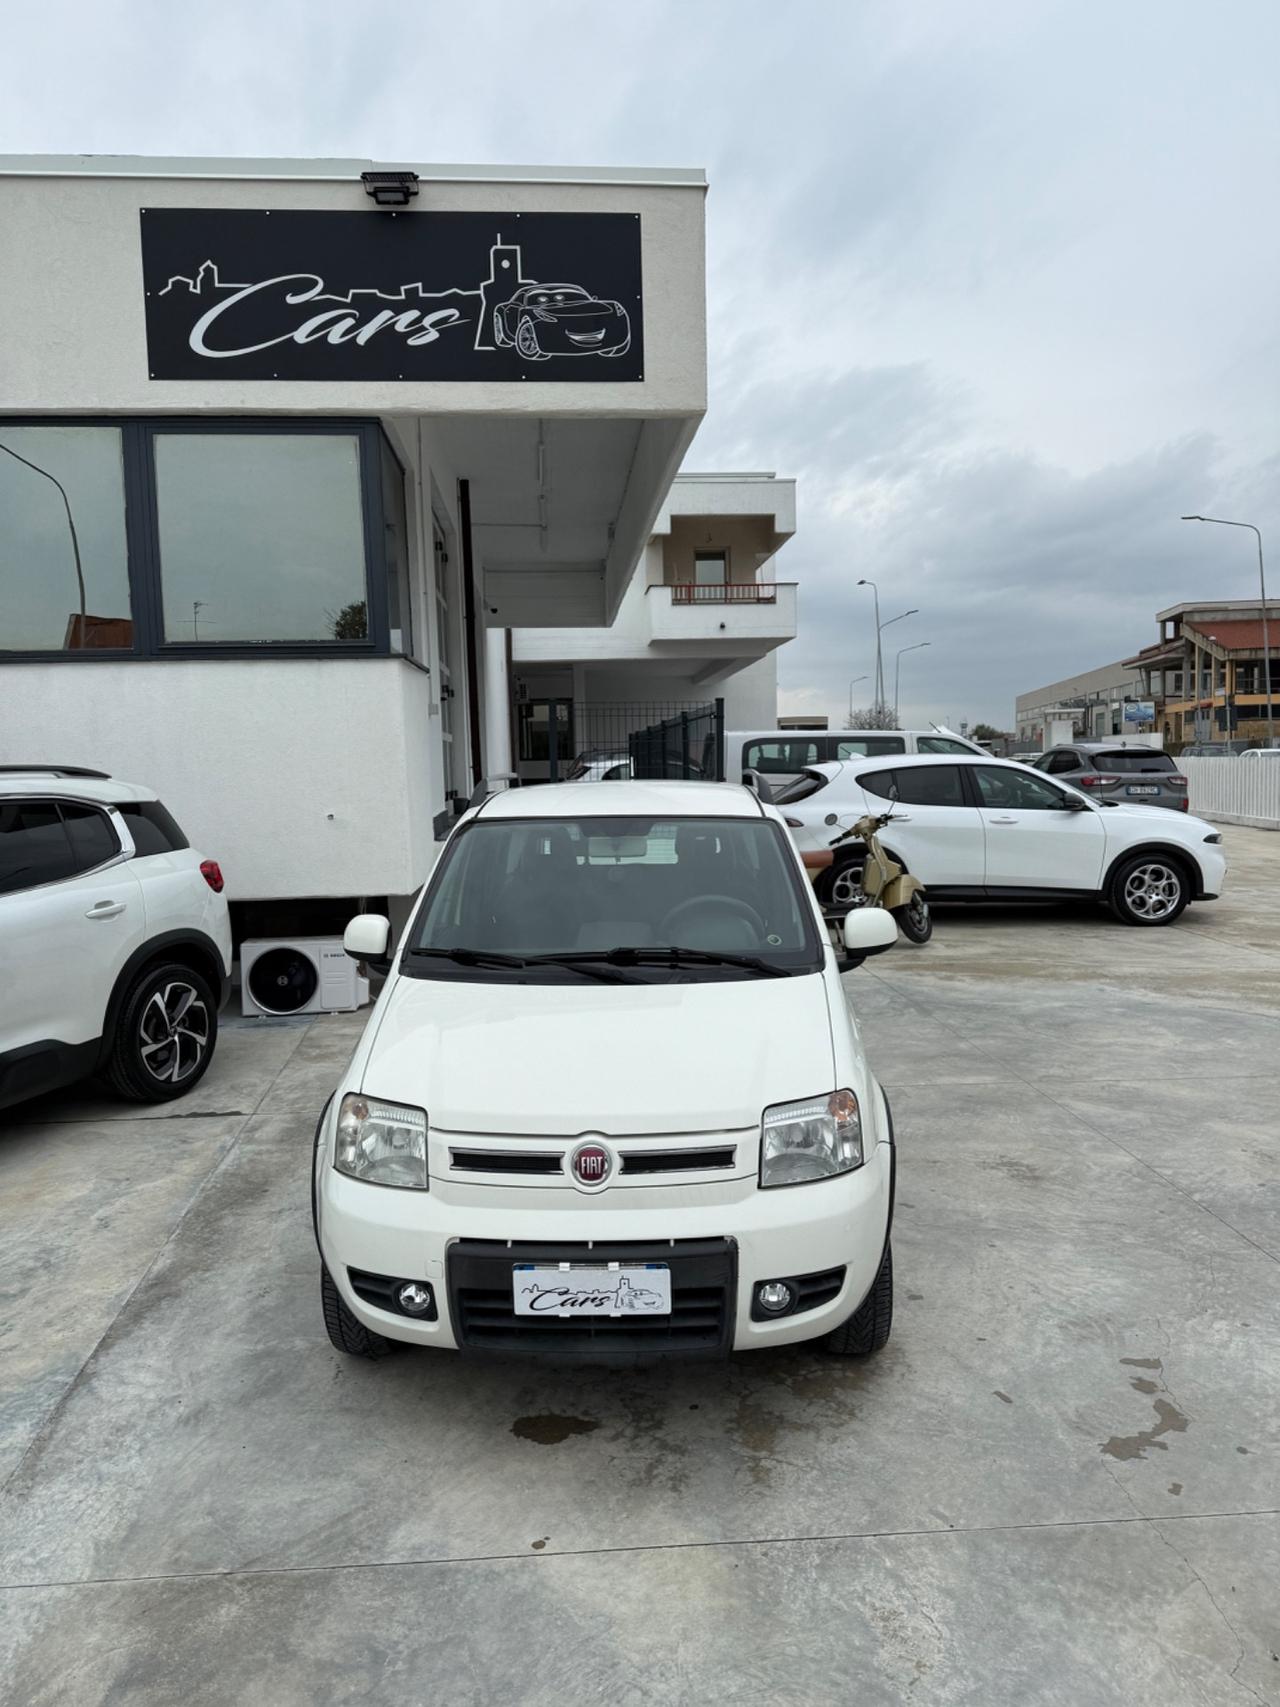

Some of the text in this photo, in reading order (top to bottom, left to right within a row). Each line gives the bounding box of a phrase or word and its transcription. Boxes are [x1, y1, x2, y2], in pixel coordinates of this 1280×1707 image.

[189, 273, 472, 358] Cars
[581, 1156, 603, 1174] FIAT
[529, 1286, 611, 1311] Cars
